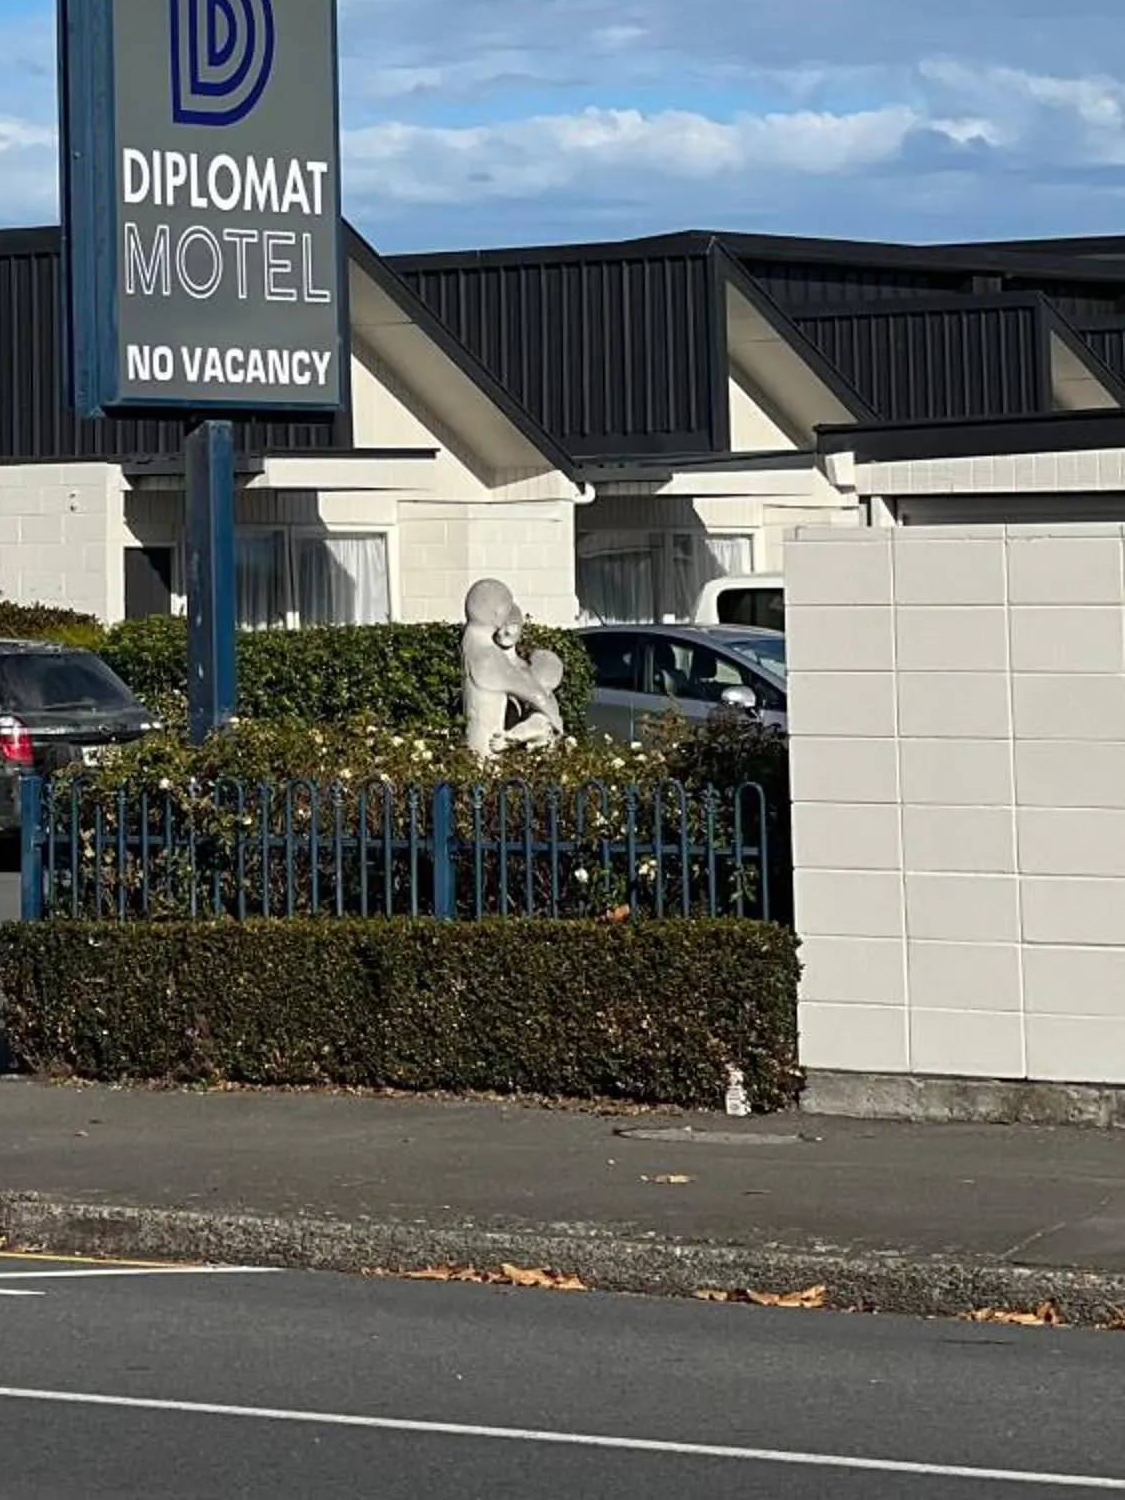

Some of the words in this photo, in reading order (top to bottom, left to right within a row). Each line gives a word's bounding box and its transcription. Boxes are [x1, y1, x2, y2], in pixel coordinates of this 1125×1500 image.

[122, 148, 328, 215] DIPLOMAT
[124, 222, 332, 303] MOTEL
[126, 344, 174, 381] NO
[180, 345, 332, 386] VACANCY
